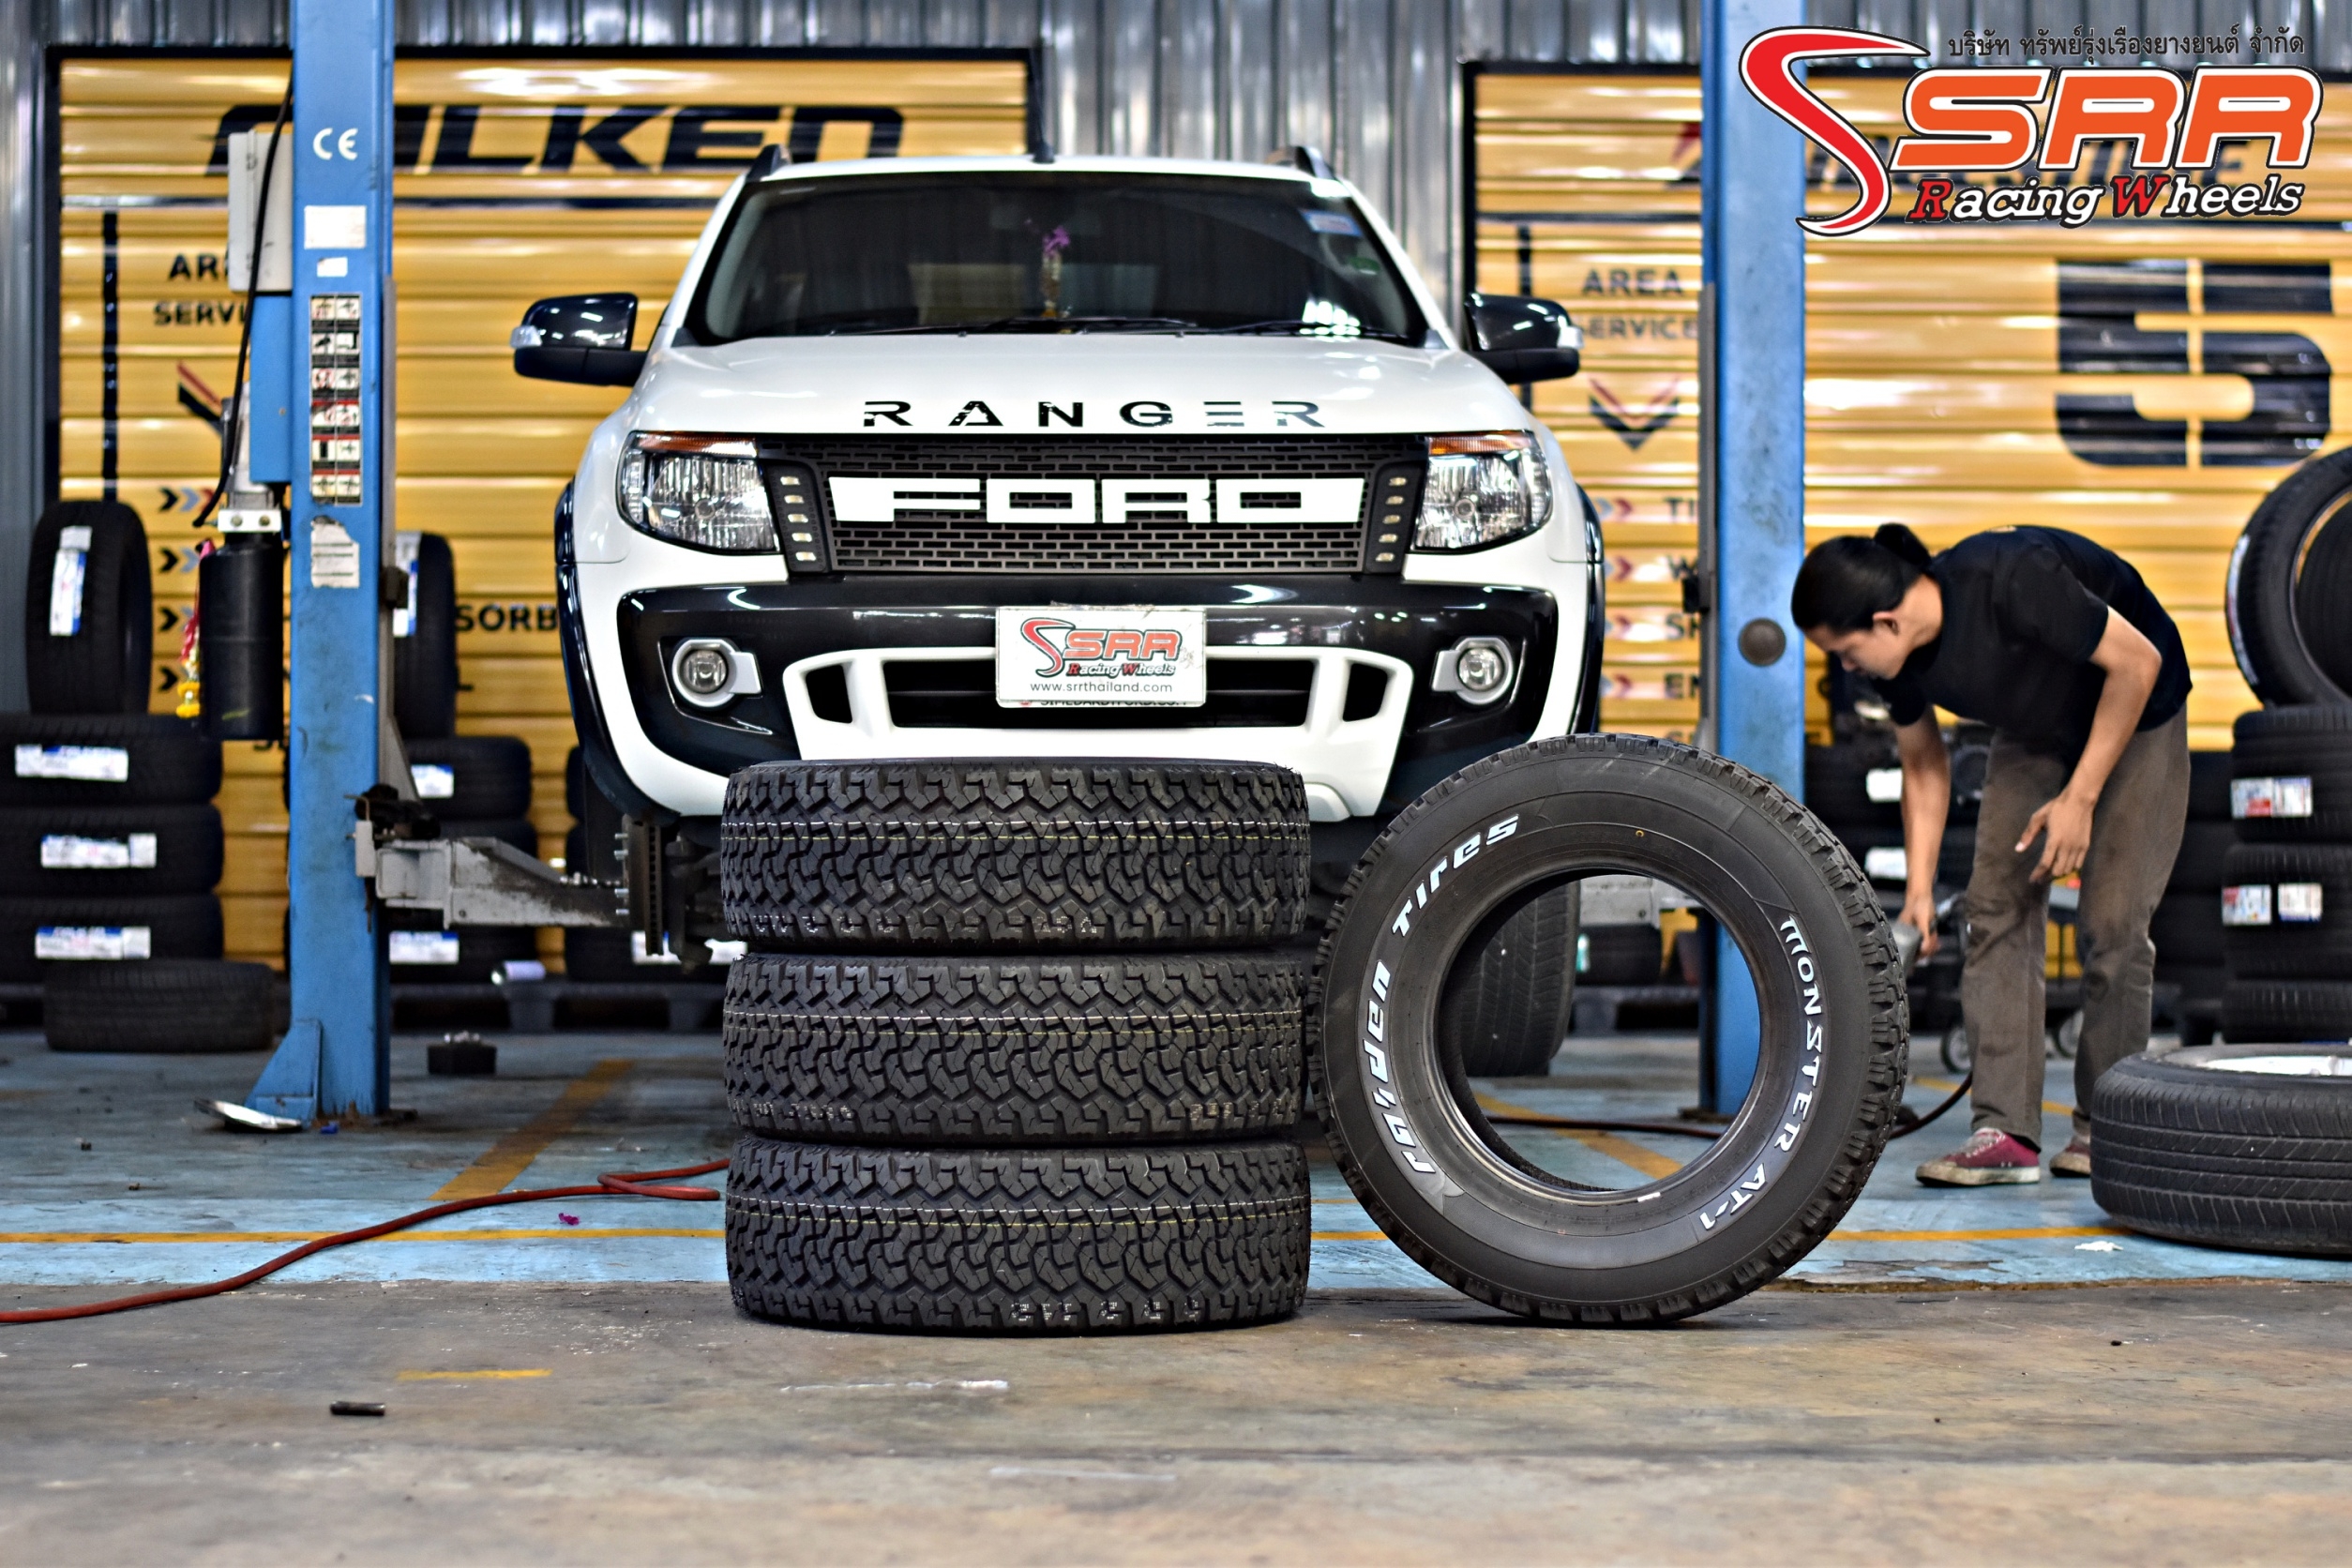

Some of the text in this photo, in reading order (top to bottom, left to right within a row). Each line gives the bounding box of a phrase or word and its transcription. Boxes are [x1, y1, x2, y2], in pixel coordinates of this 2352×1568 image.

[205, 104, 905, 175] FLKEN
[1581, 268, 1684, 296] AREA
[1581, 317, 1699, 340] ERVICE
[863, 400, 1326, 428] RANGER
[828, 476, 1365, 524] FORD
[1065, 662, 1177, 678] Racing Wheels
[1030, 681, 1173, 693] www.srrthailand.com
[1698, 913, 1824, 1231] MONSTER AT-1
